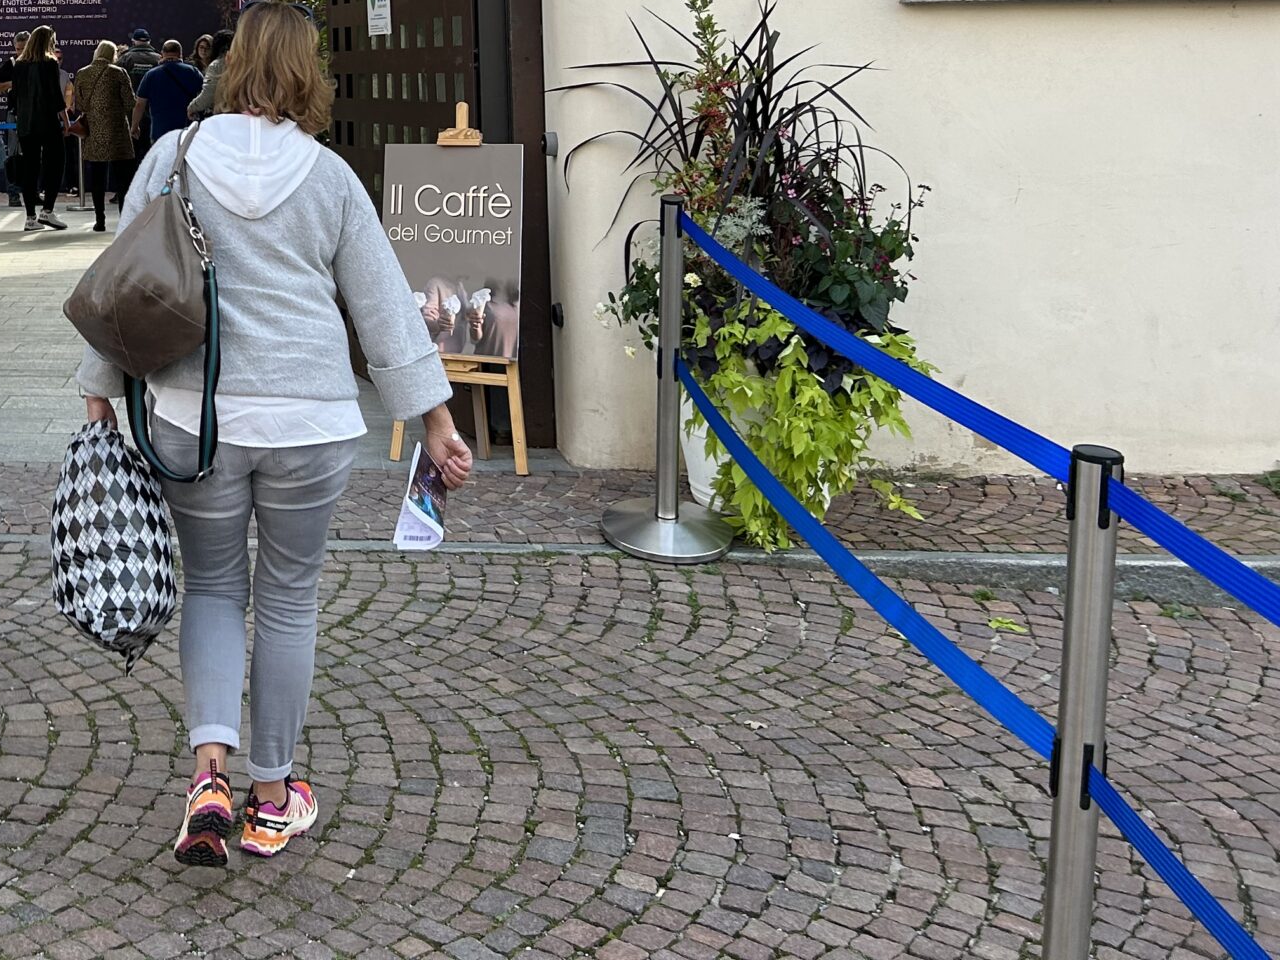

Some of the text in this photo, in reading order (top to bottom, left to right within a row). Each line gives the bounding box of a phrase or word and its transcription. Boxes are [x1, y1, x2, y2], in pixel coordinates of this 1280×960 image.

[391, 182, 512, 218] Il Caffè
[388, 223, 513, 246] del Gourmet
